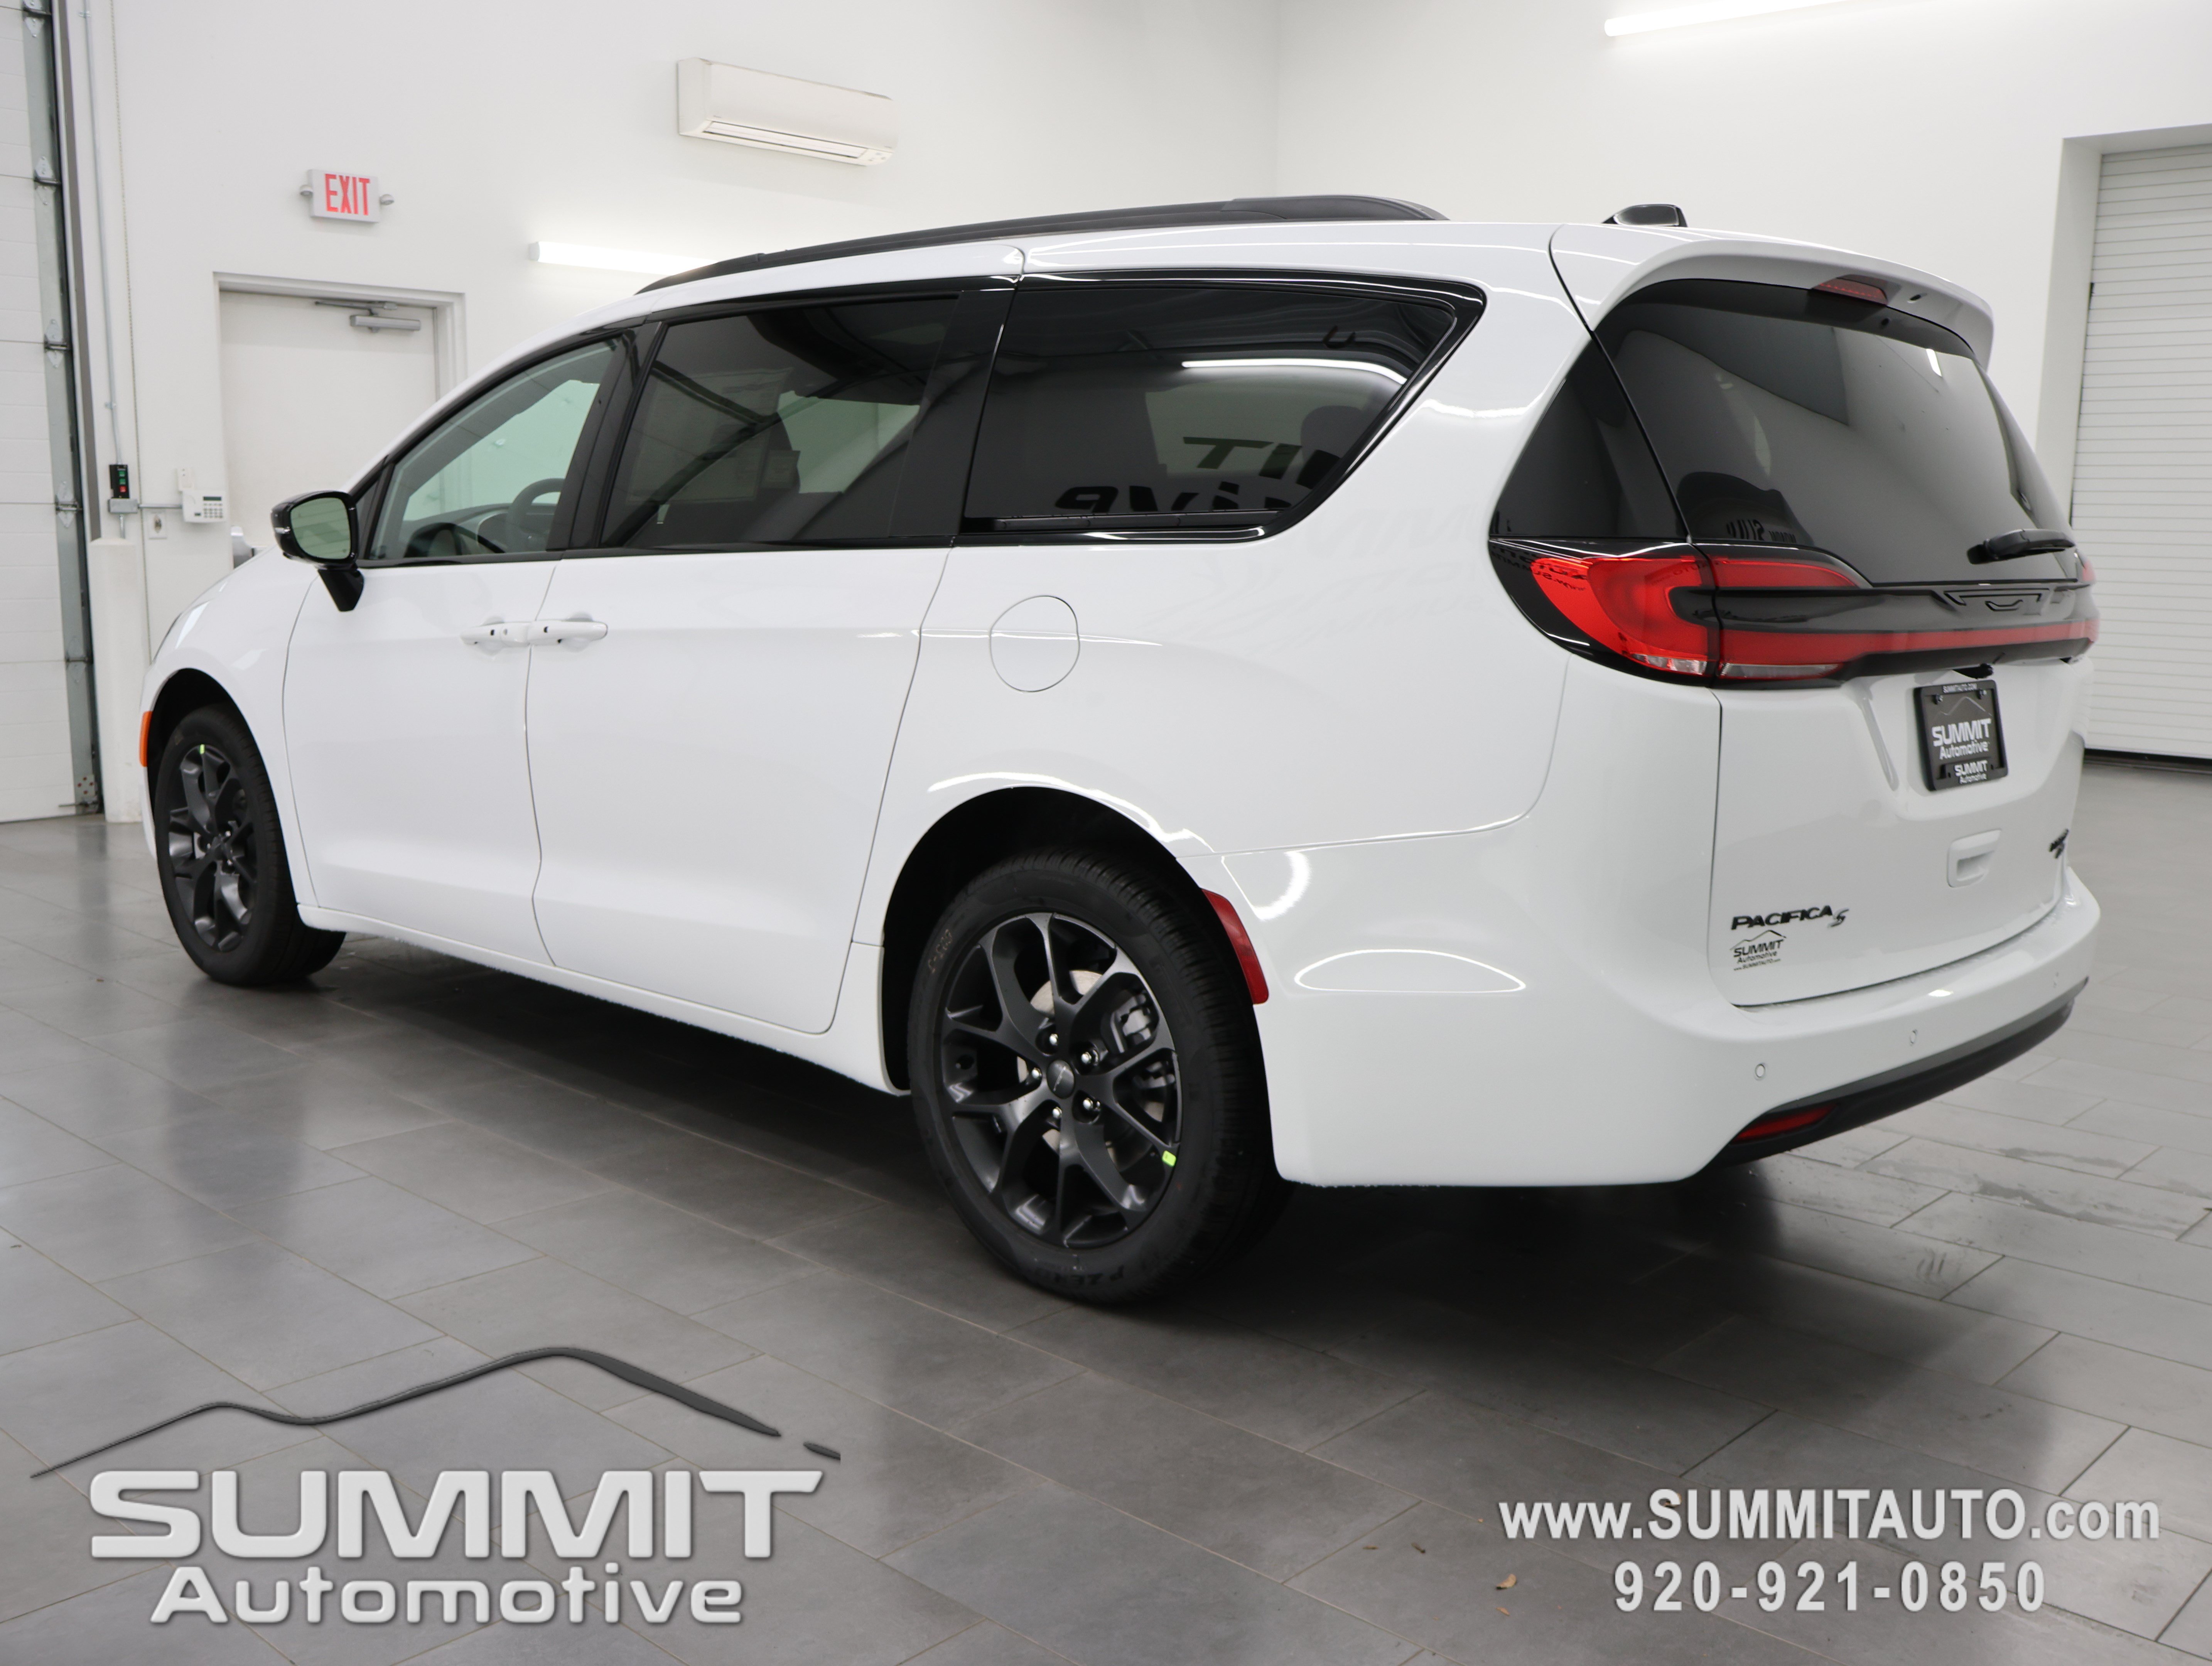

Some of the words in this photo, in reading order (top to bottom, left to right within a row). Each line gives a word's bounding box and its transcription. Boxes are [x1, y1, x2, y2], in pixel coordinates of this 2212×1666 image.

[325, 174, 370, 216] EXIT
[1932, 718, 1992, 747] SUMMIT
[1939, 739, 1989, 760] Automotive
[1954, 760, 1988, 777] SUMMIT
[1959, 772, 1987, 784] Automotive
[1731, 905, 1833, 930] PACIFICA
[1827, 909, 1849, 928] S
[1733, 939, 1784, 957] SUMMIT
[1737, 951, 1778, 964] Automotive
